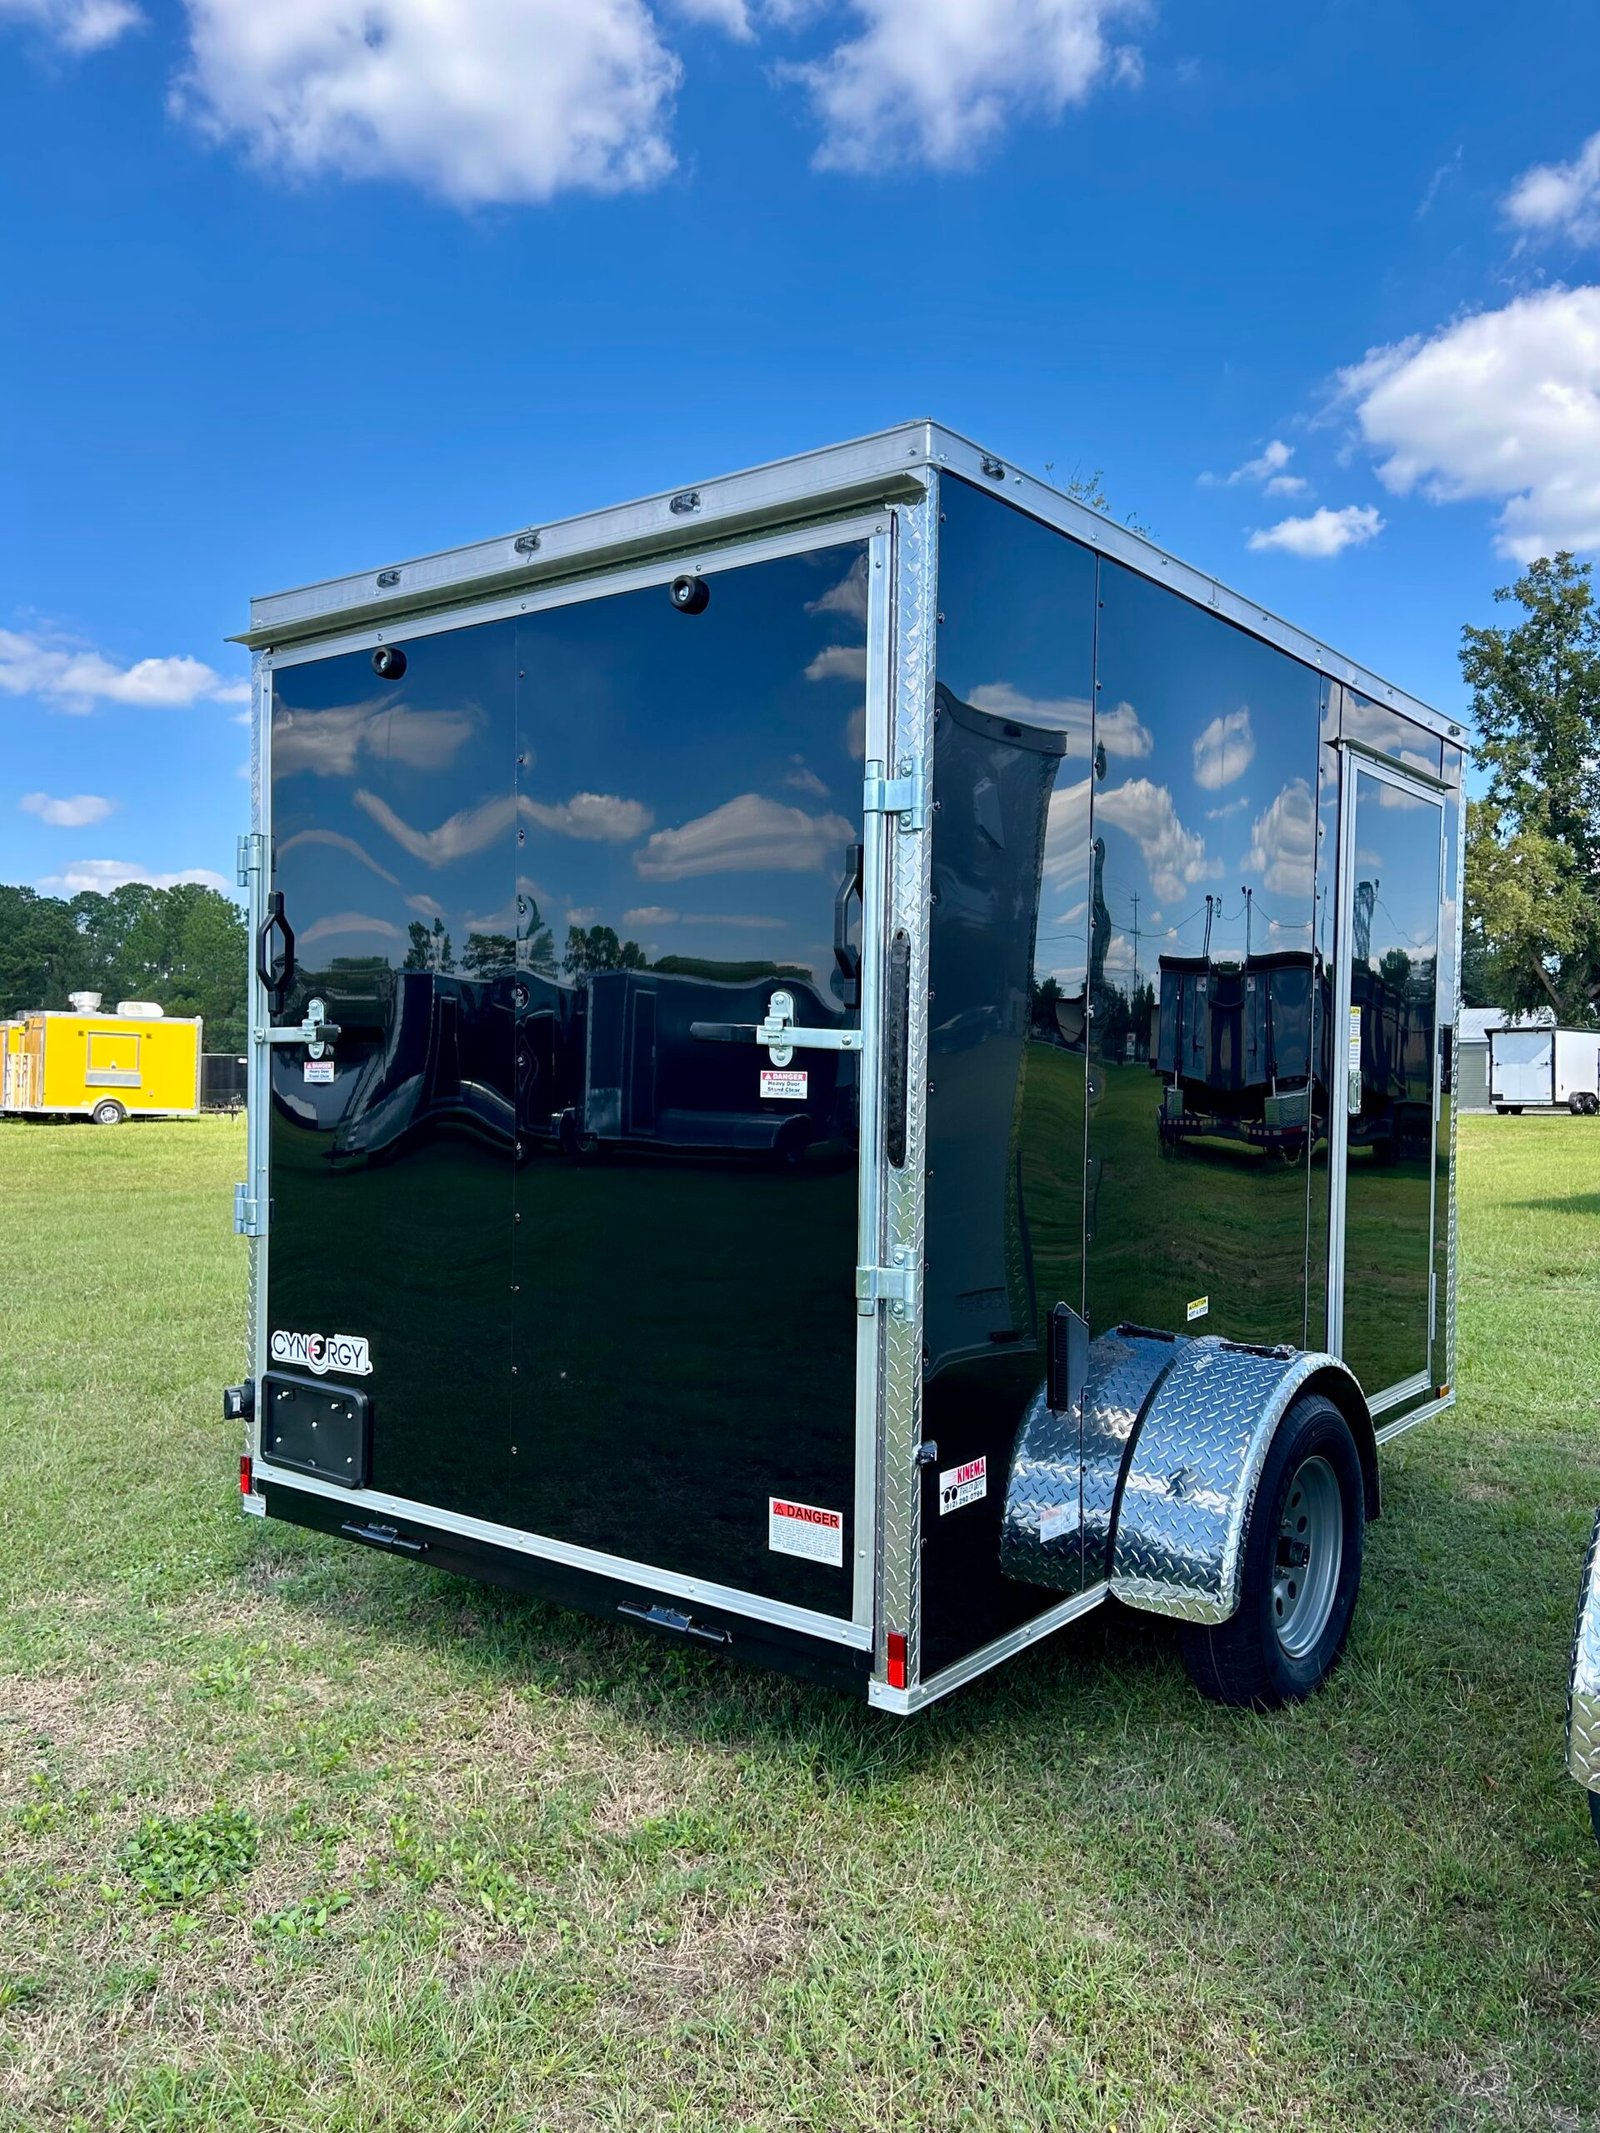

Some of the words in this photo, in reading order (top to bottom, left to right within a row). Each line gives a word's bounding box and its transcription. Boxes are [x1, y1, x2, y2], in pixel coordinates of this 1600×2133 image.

[772, 1073, 804, 1081] DANGER
[273, 1333, 363, 1369] CYNERGY
[957, 1459, 985, 1484] KINEMA
[786, 1504, 839, 1528] DANGER
